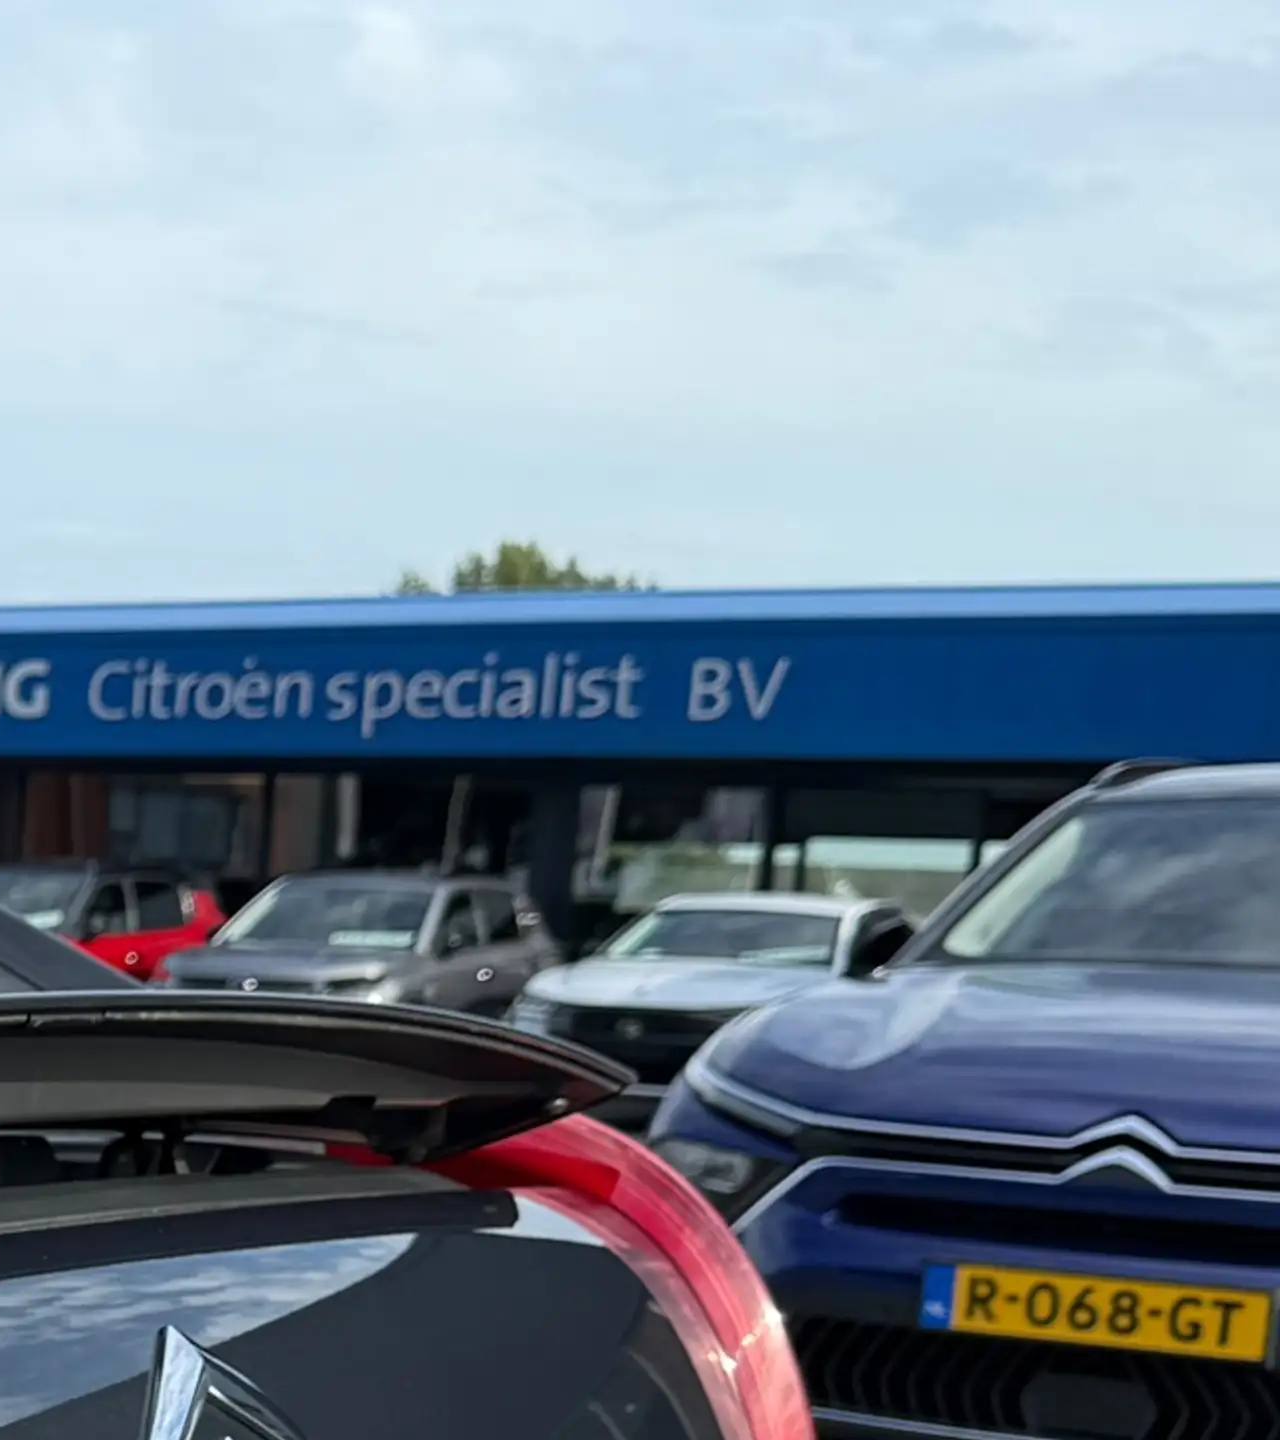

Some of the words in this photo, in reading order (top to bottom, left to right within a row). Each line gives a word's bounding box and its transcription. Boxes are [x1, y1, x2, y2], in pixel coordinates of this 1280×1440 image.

[324, 650, 646, 740] specialist
[686, 656, 792, 722] BV
[963, 1275, 1247, 1348] R-068-GT
